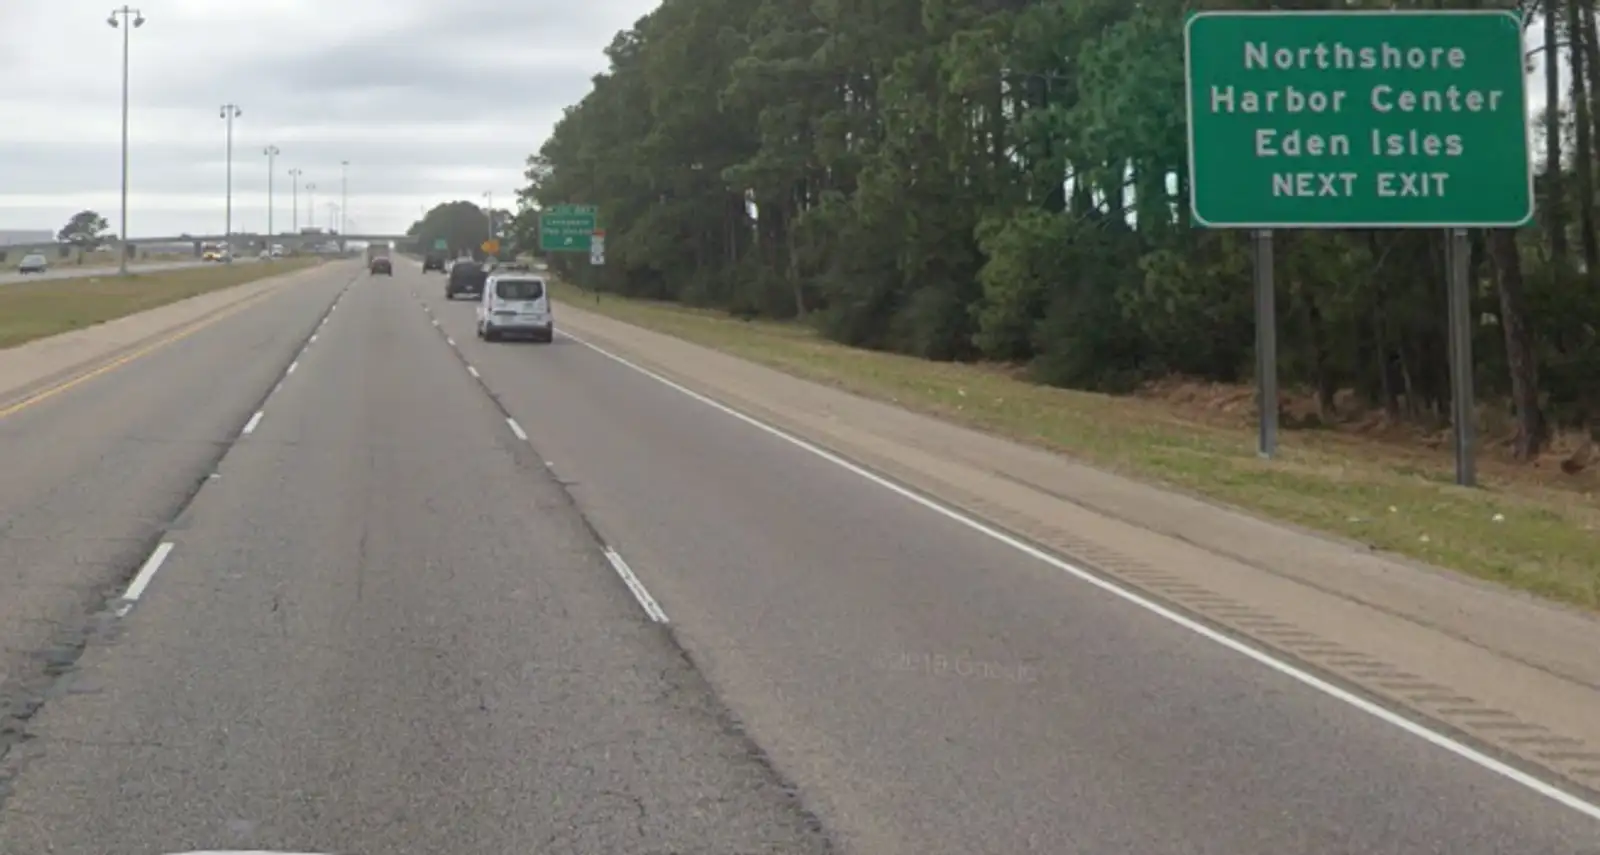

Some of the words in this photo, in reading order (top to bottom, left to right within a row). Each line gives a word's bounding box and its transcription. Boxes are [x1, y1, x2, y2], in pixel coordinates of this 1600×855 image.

[1244, 41, 1465, 69] Northshore
[1210, 86, 1346, 113] Harbor
[1371, 85, 1502, 112] Center
[1255, 128, 1349, 157] Eden
[1372, 129, 1463, 156] Isles
[1272, 172, 1358, 197] NEXT
[1377, 172, 1449, 197] EXIT
